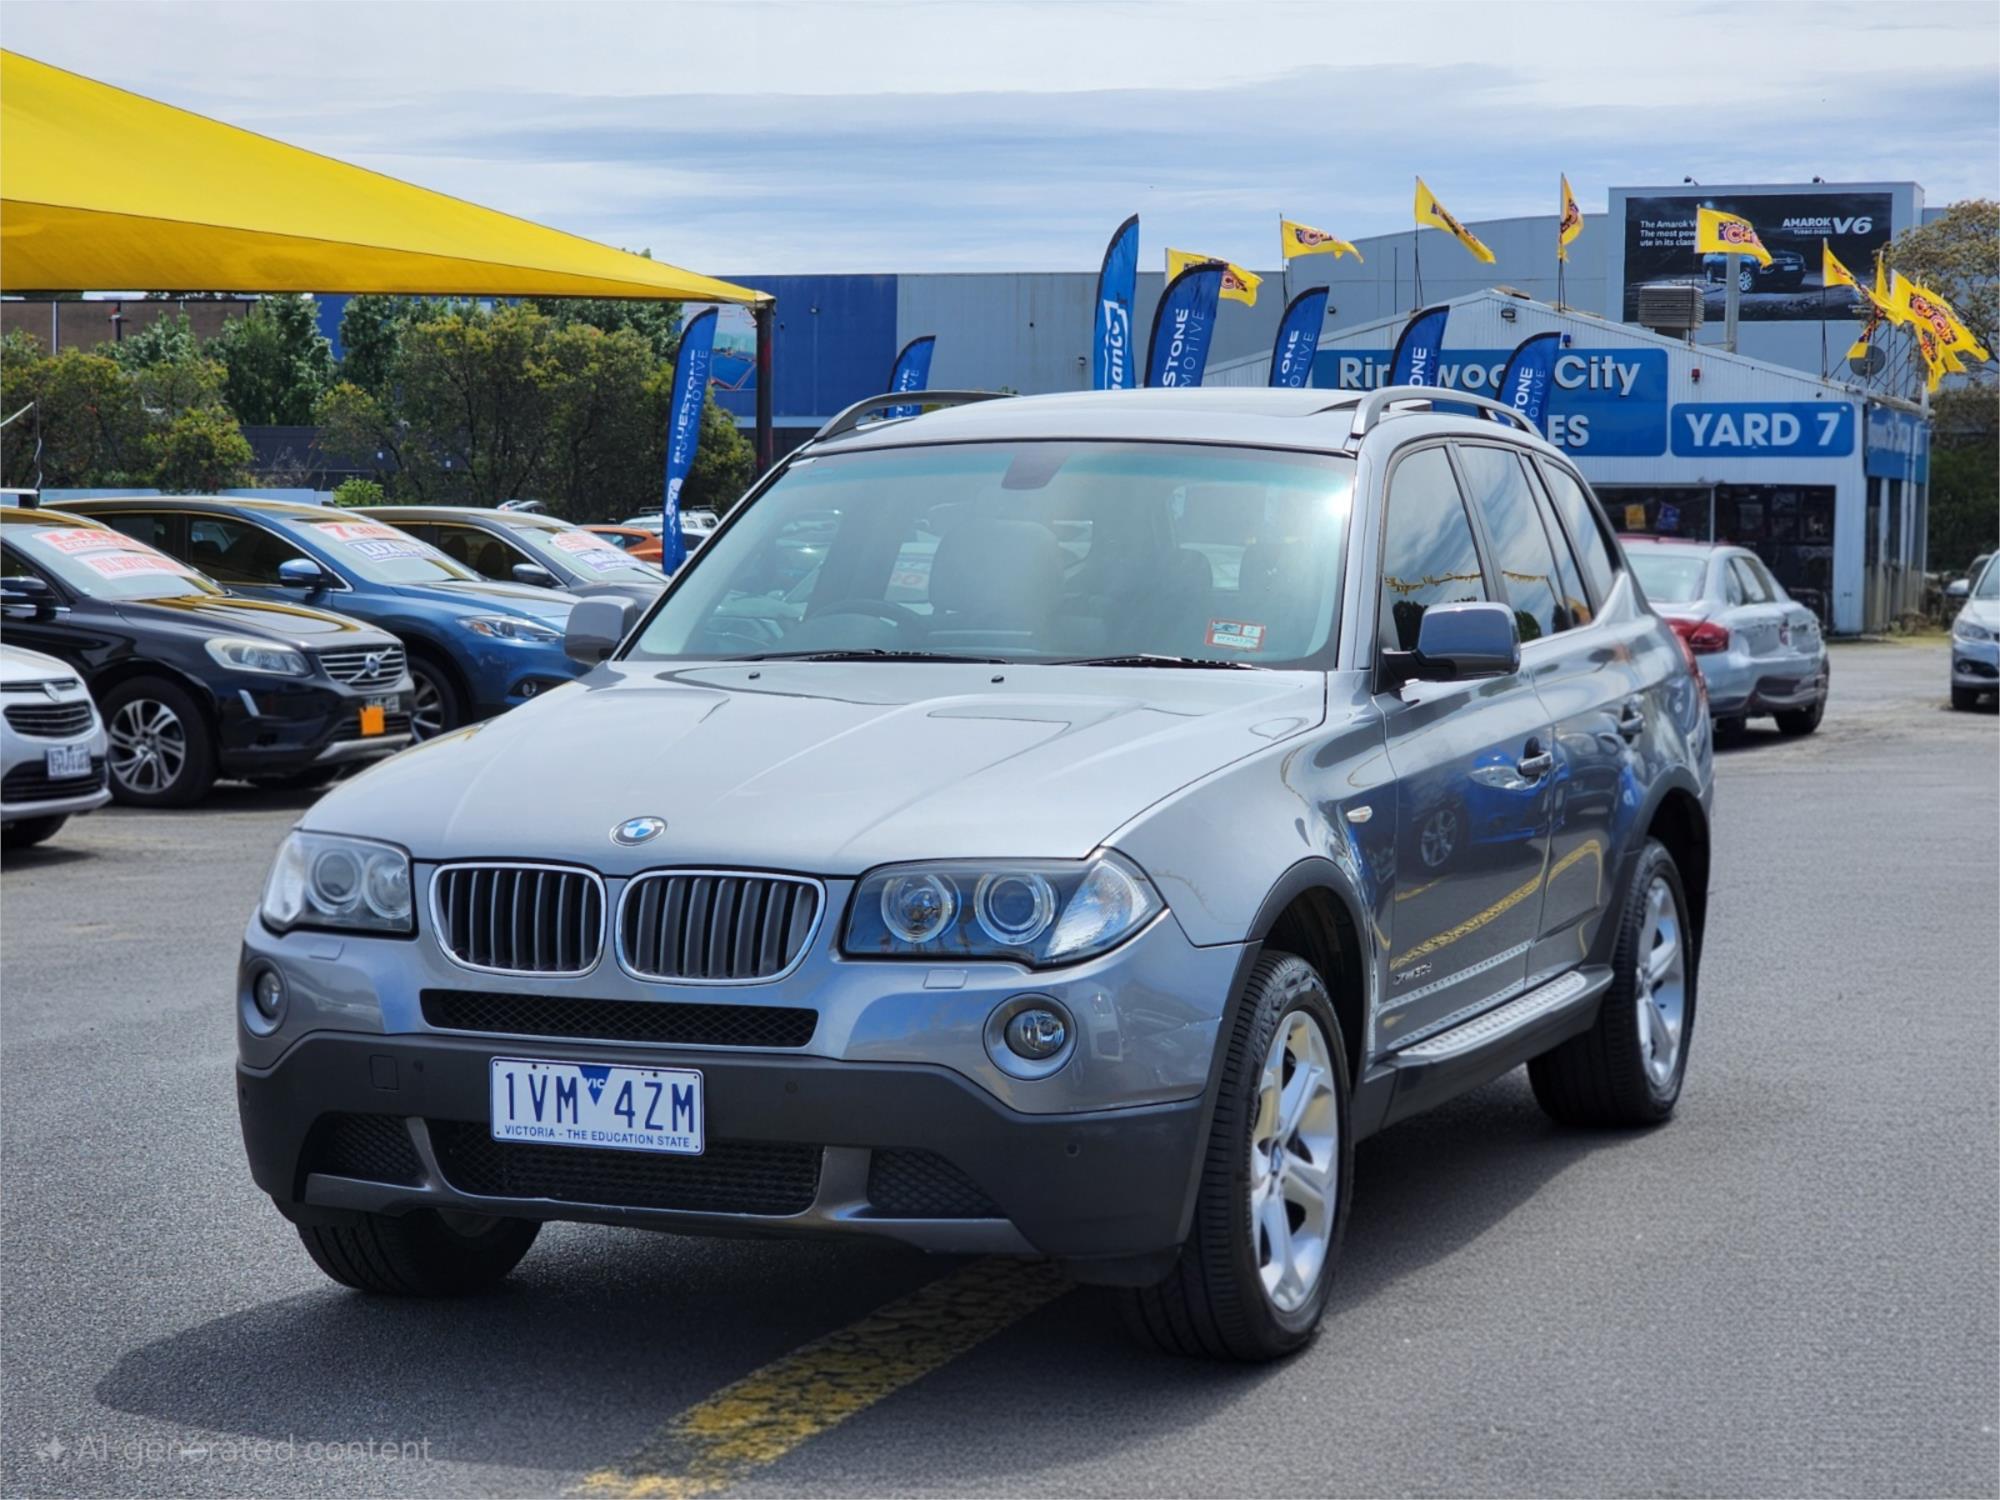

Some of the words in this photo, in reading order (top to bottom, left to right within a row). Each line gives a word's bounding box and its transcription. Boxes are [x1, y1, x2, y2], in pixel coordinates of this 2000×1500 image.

[1640, 220, 1655, 228] The
[1640, 229, 1655, 238] The
[1678, 231, 1697, 240] pow
[1782, 217, 1832, 227] AMAROK
[1832, 216, 1873, 235] V6
[1162, 308, 1190, 388] STONE
[1179, 309, 1205, 388] MOTIVE
[1281, 330, 1300, 375] ONE
[1289, 331, 1315, 388] OTIVE
[1409, 347, 1427, 387] ONE
[1528, 368, 1546, 417] OTIVE
[1554, 354, 1641, 396] City
[1547, 414, 1590, 447] ES
[1685, 412, 1800, 447] YARD
[1816, 412, 1840, 447] 7
[505, 1072, 579, 1125] 1VM
[613, 1079, 695, 1133] 4ZM
[504, 1124, 556, 1138] VICTORIA
[566, 1129, 587, 1140] THE
[591, 1131, 654, 1146] EDUCATION
[657, 1134, 690, 1148] STATE
